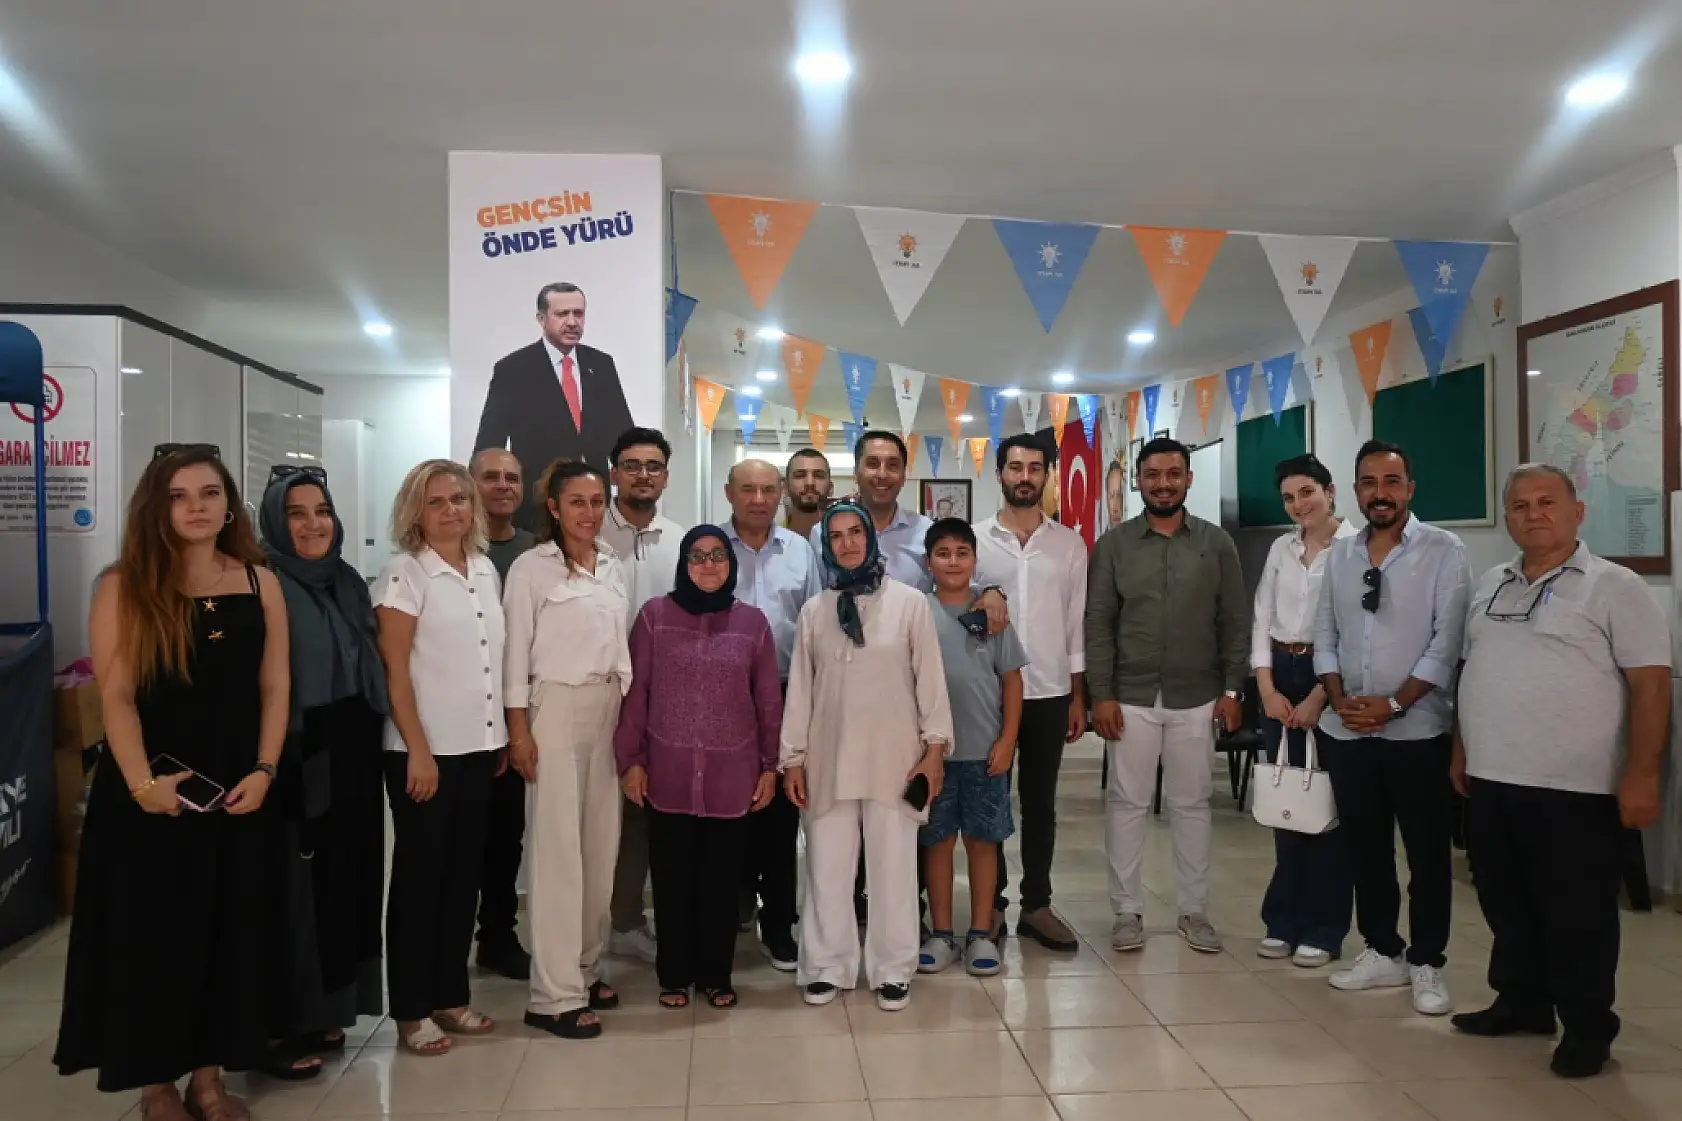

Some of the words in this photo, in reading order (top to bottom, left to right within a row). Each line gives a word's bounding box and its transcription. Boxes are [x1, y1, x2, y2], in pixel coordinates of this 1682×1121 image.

[477, 190, 592, 227] GENÇSİN
[482, 227, 557, 258] ÖNDE
[560, 210, 634, 246] YÜRÜ
